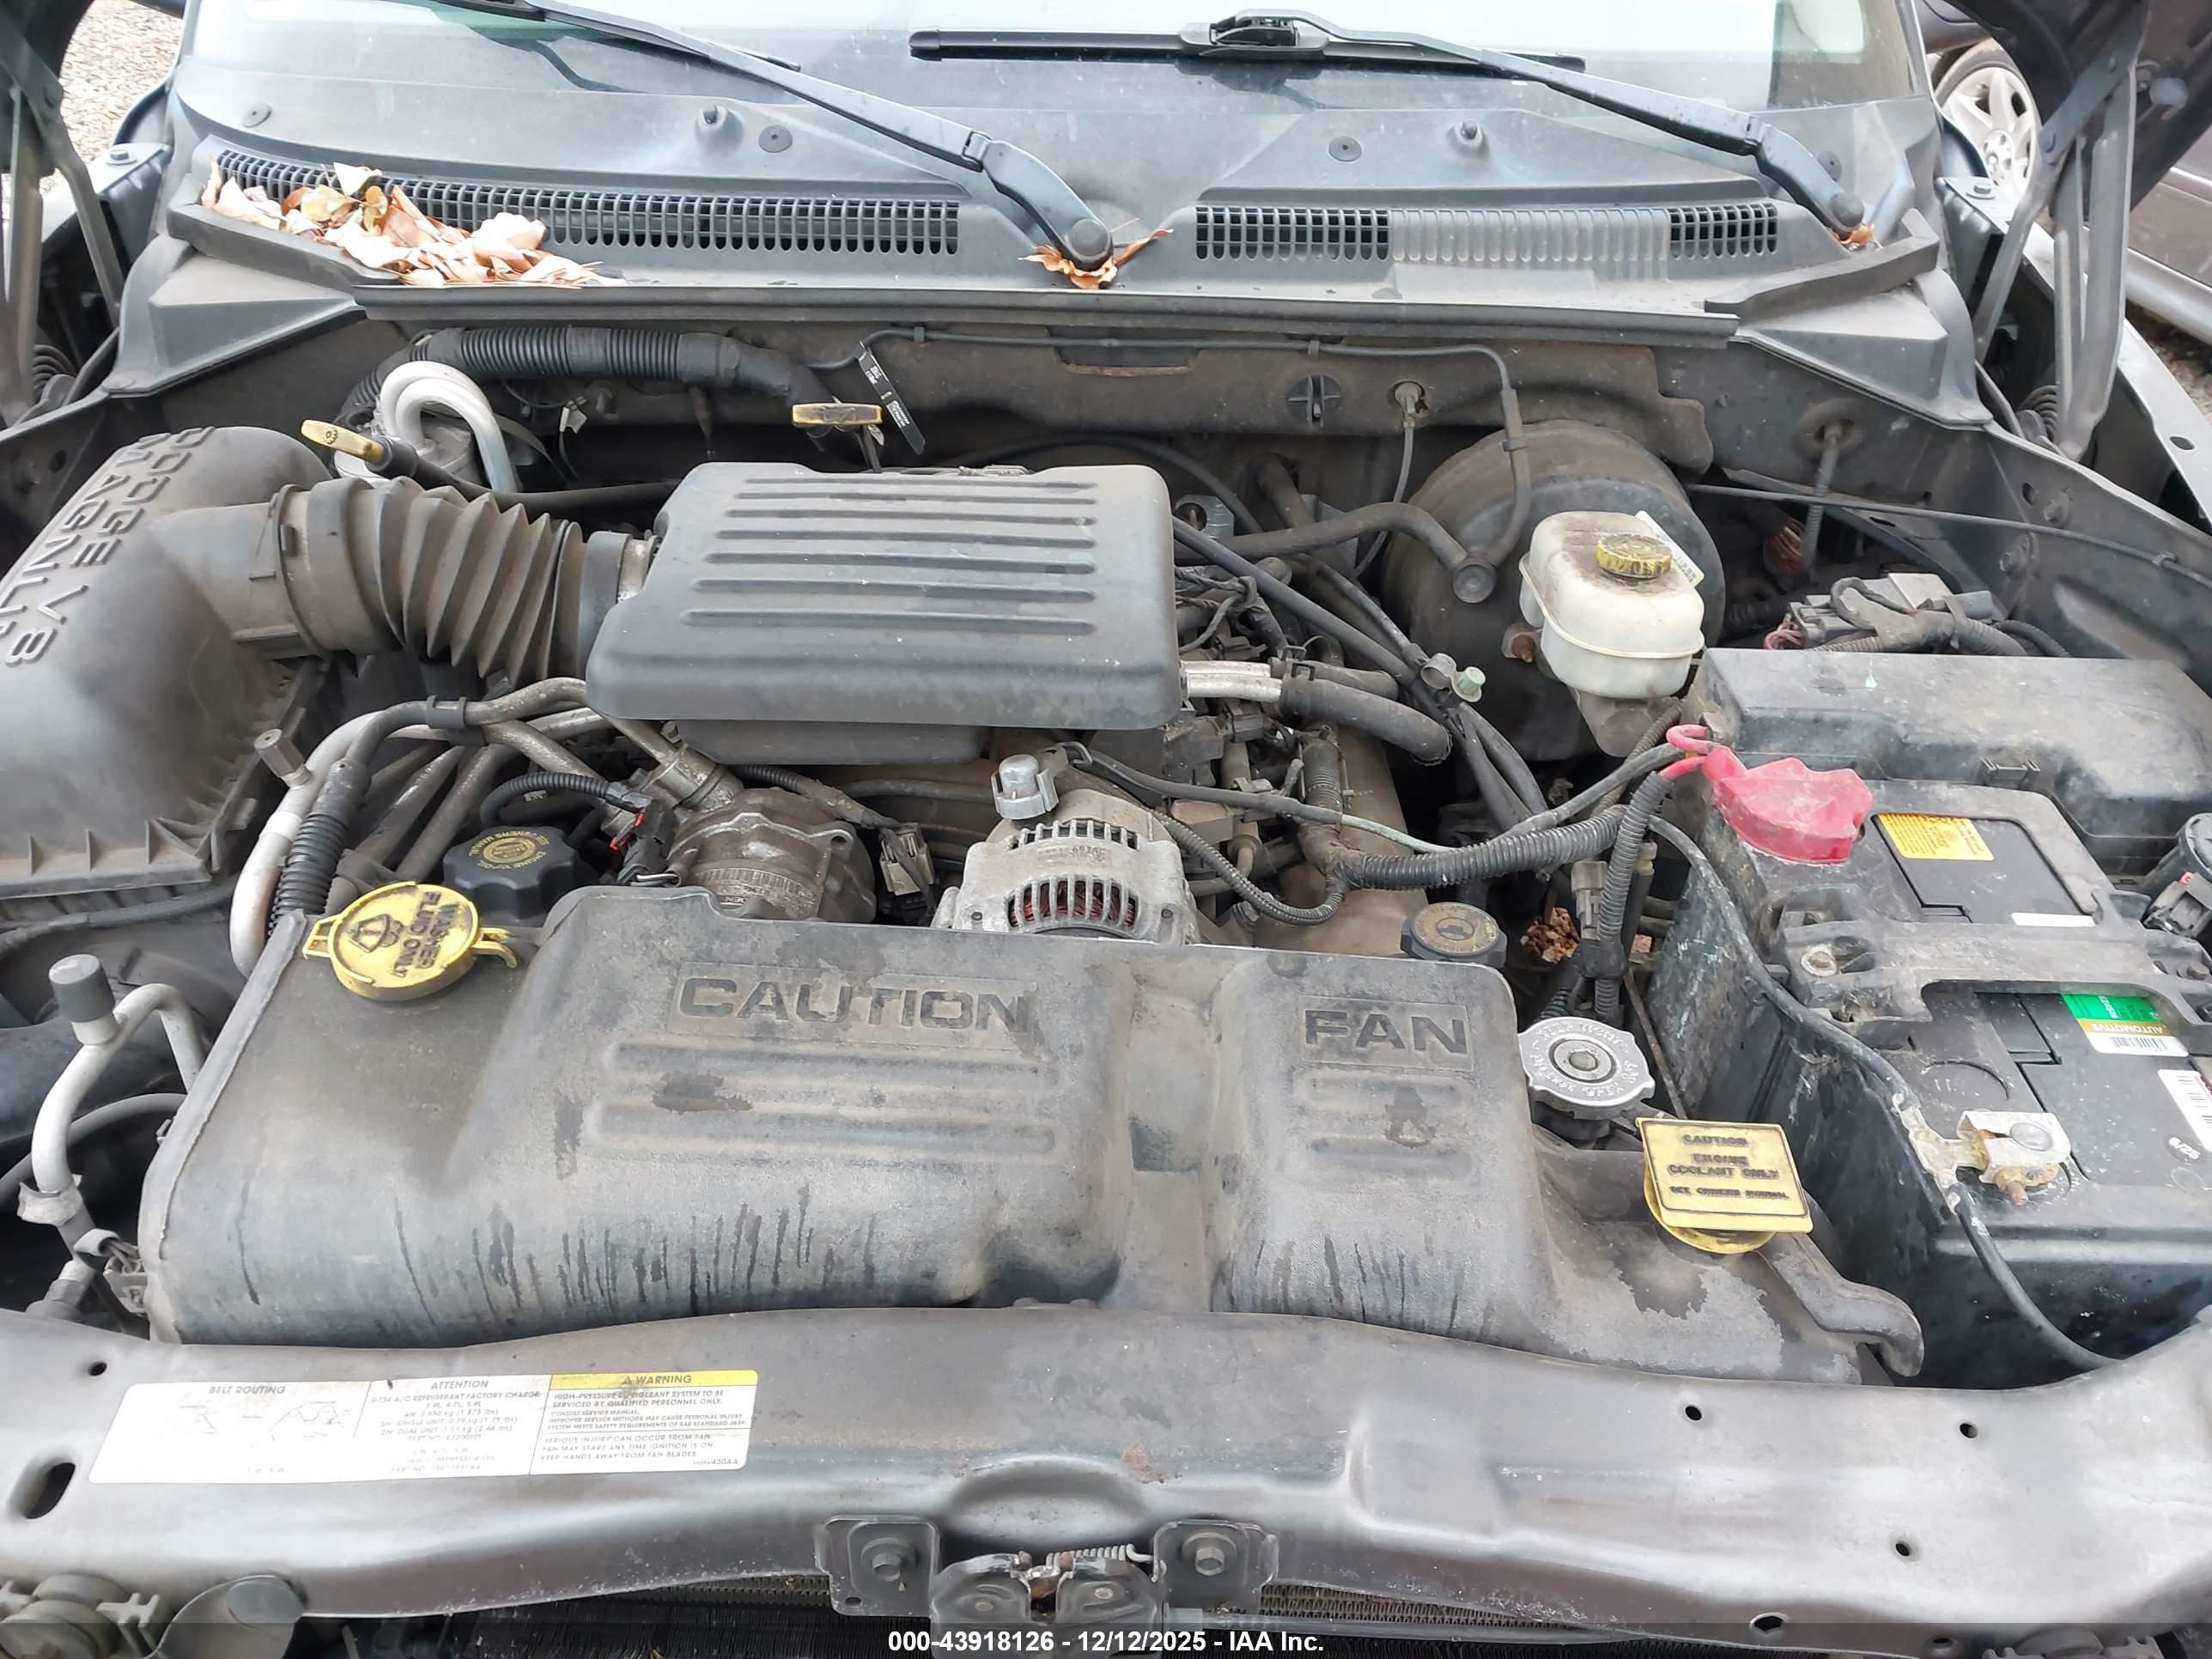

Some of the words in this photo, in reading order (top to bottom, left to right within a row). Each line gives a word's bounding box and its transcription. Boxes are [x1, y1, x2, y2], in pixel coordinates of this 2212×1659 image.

[70, 426, 215, 568] DODGE
[4, 584, 89, 668] V8
[408, 891, 441, 936] FLUID
[415, 903, 459, 969] WASHER
[390, 938, 422, 978] ONLY
[679, 977, 1031, 1033] CAUTION
[1304, 1009, 1468, 1054] FAN
[2091, 1023, 2164, 1034] AUTOMOTIVE
[1682, 1134, 1749, 1147] CAUTION
[1692, 1153, 1749, 1166] ENGINE
[1668, 1164, 1735, 1176] COOLANT
[1741, 1168, 1779, 1180] ONLY
[1669, 1186, 1691, 1196] SEE
[1744, 1189, 1790, 1200] MANUAL
[430, 1380, 489, 1389] ATTENTION
[636, 1375, 692, 1384] WARNING
[208, 1385, 233, 1395] BELT
[234, 1385, 286, 1395] ROUTING
[413, 1393, 465, 1401] REFRIGERANT
